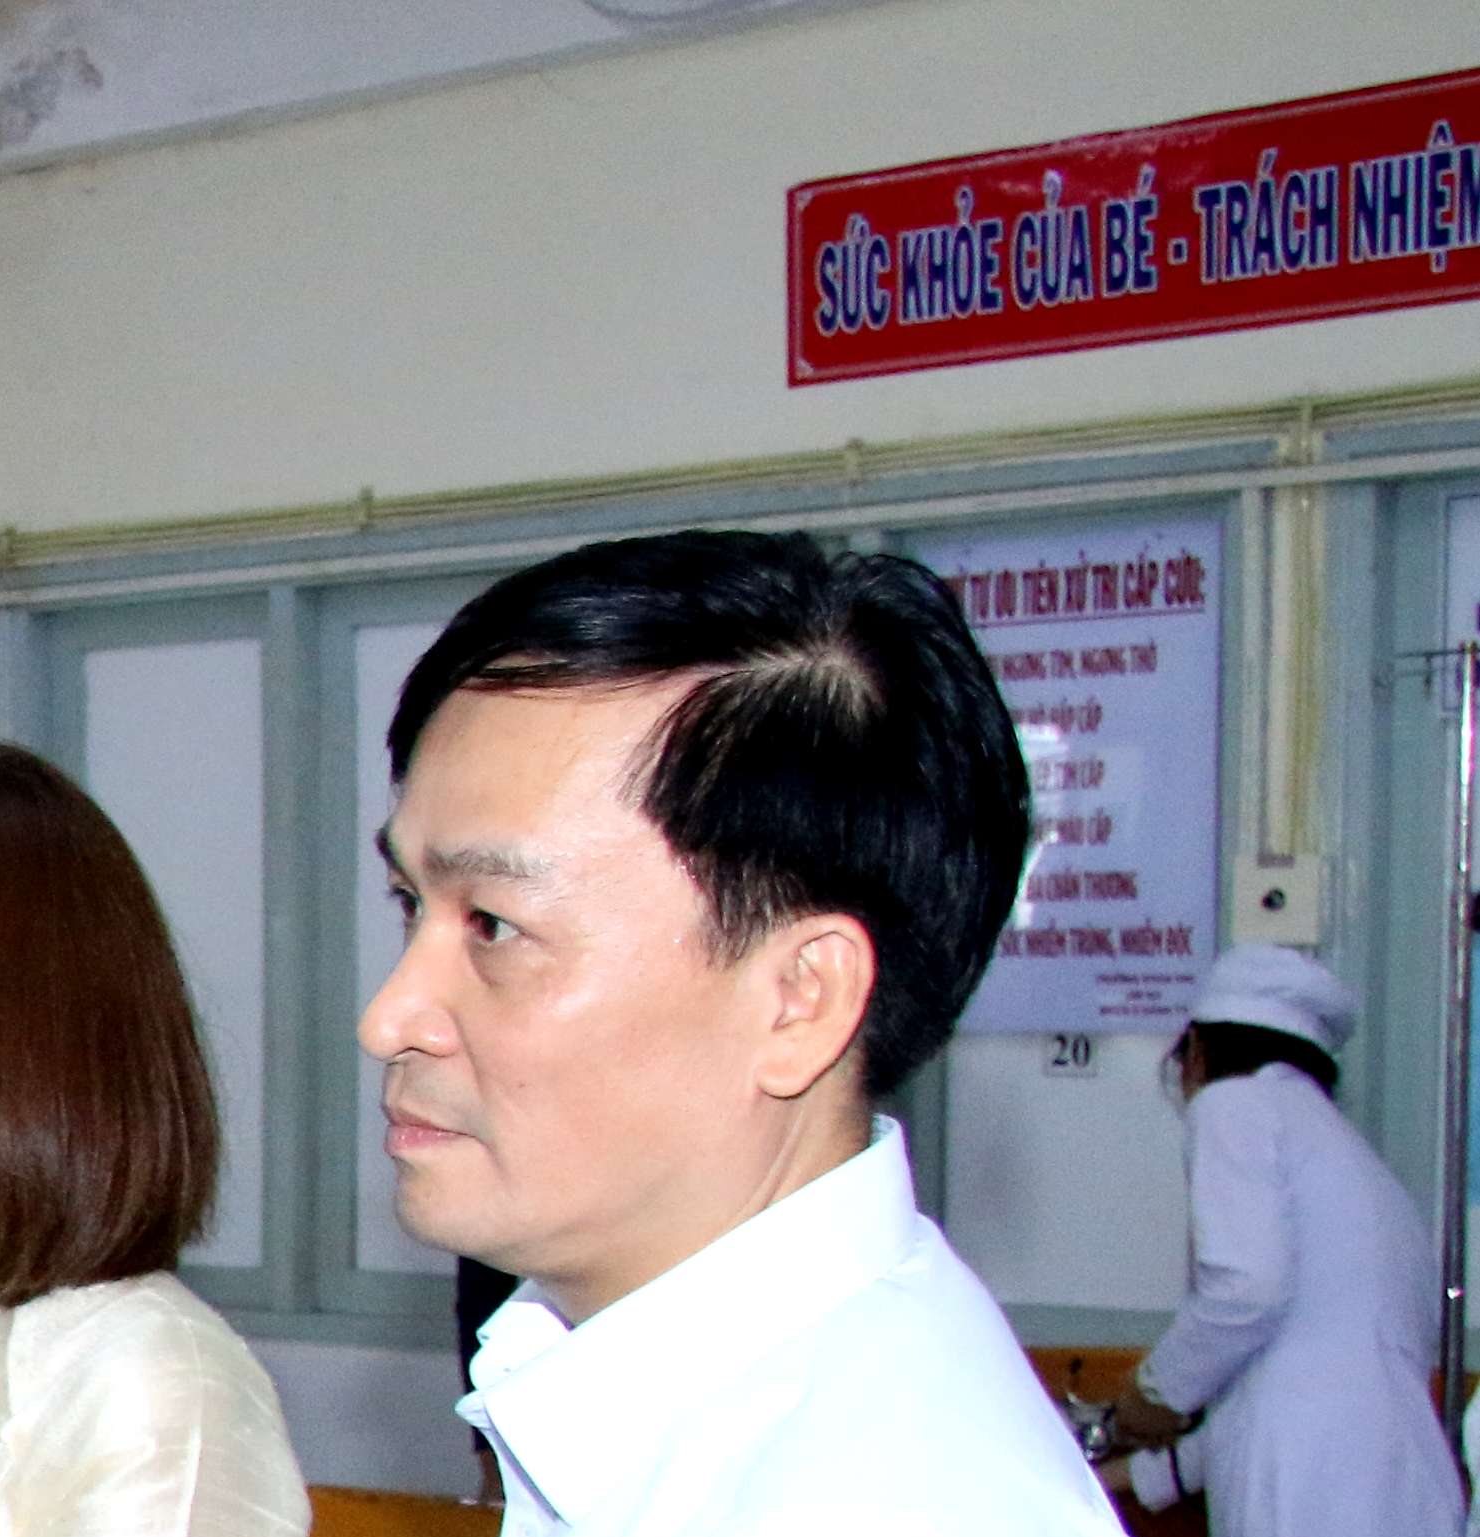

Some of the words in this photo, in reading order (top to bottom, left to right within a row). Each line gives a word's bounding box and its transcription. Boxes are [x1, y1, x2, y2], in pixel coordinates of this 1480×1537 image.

[816, 214, 890, 335] SỨC
[899, 186, 1003, 323] KHỎE
[1011, 169, 1092, 311] CỦA
[1102, 164, 1157, 298] BÉ
[1195, 148, 1338, 284] TRÁCH
[1051, 1033, 1090, 1068] 20
